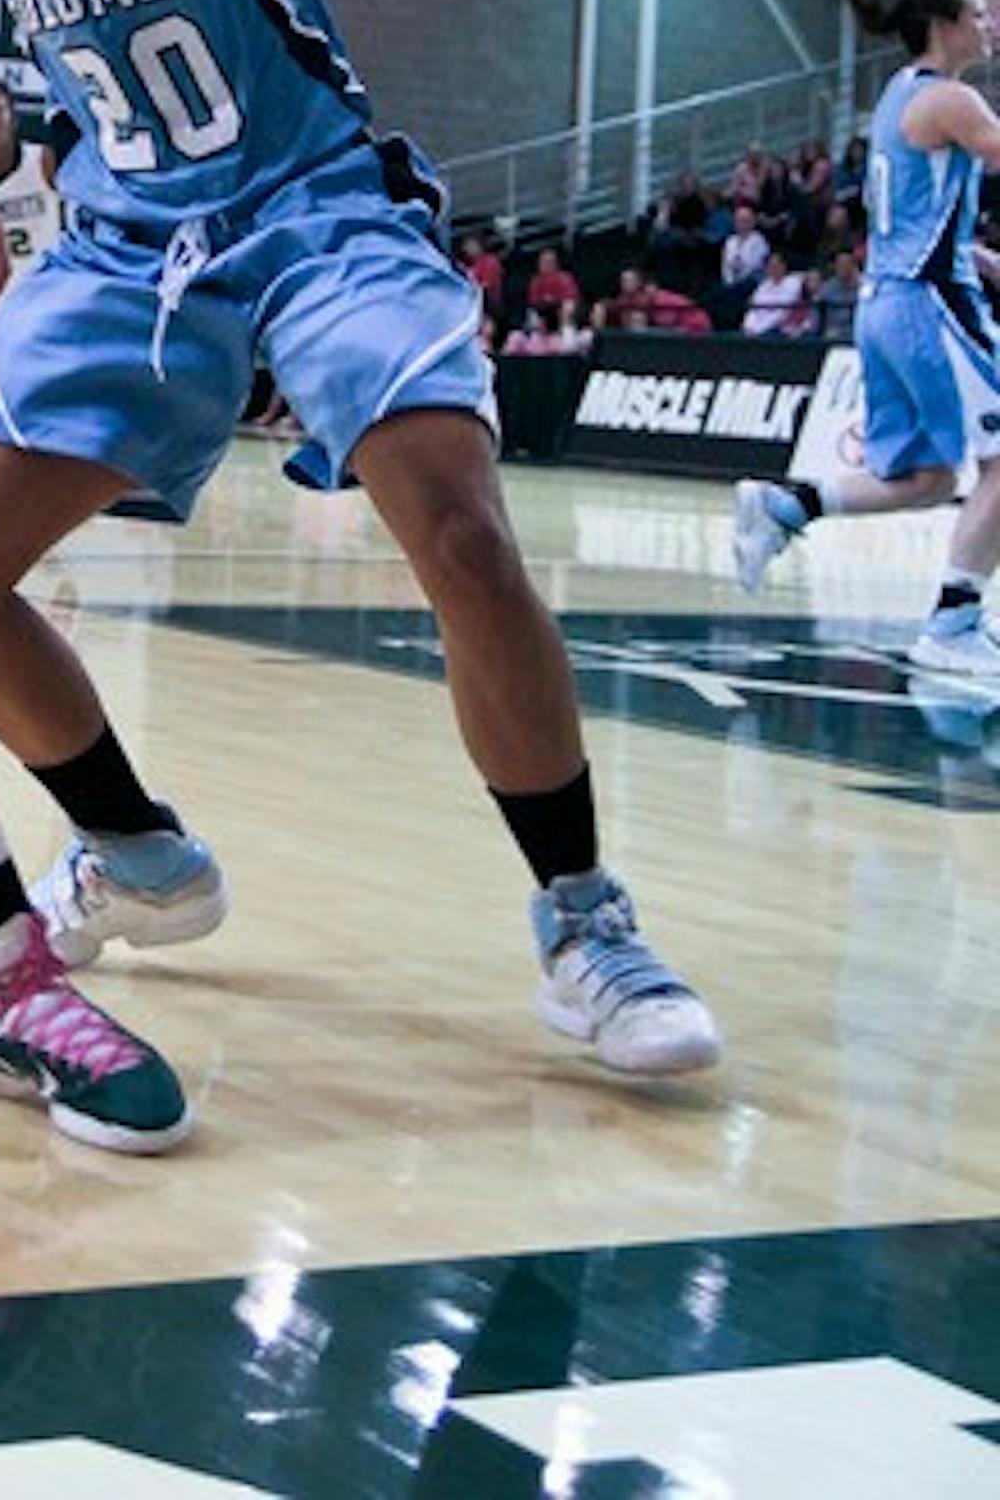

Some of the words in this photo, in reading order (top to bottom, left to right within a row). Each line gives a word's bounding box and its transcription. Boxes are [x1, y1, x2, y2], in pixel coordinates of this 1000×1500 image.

[60, 14, 243, 172] 20
[575, 370, 713, 434] MUSCLE
[704, 375, 817, 441] MILK
